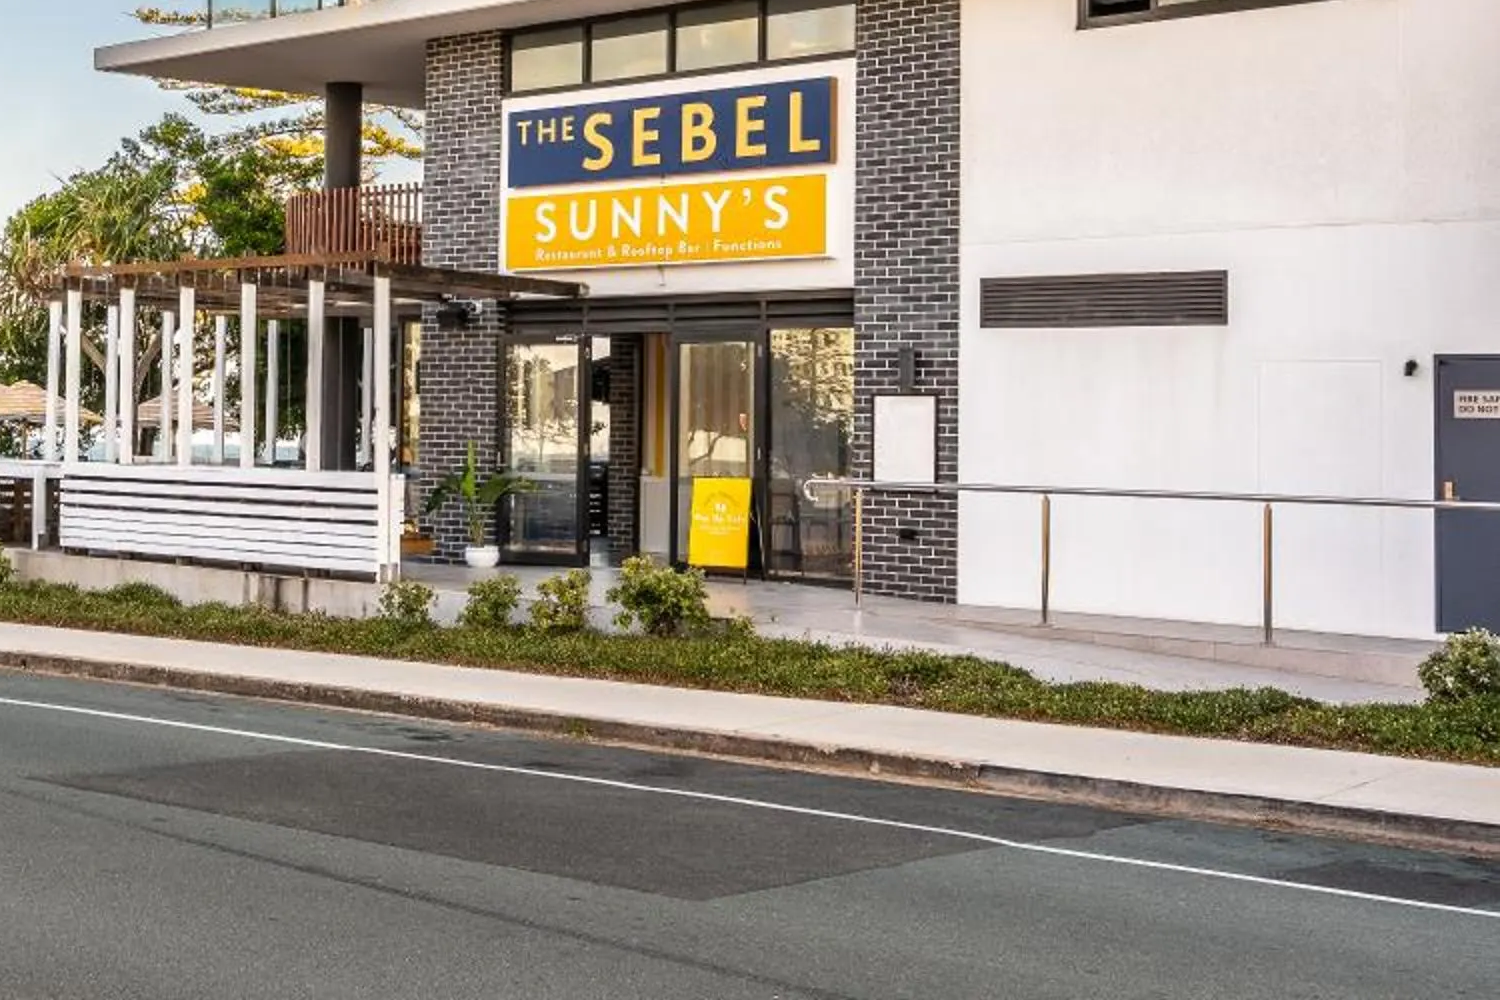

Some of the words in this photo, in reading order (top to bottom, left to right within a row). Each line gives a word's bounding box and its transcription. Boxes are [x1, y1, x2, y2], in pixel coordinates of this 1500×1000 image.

[516, 115, 575, 146] THE
[582, 91, 822, 172] SEBEL
[534, 185, 790, 243] SUNNY'S
[535, 247, 603, 261] Restaurant
[607, 245, 617, 257] &
[621, 242, 673, 260] Rooftop
[678, 240, 701, 254] Bar
[713, 238, 782, 252] Functions
[1478, 405, 1498, 413] NOT
